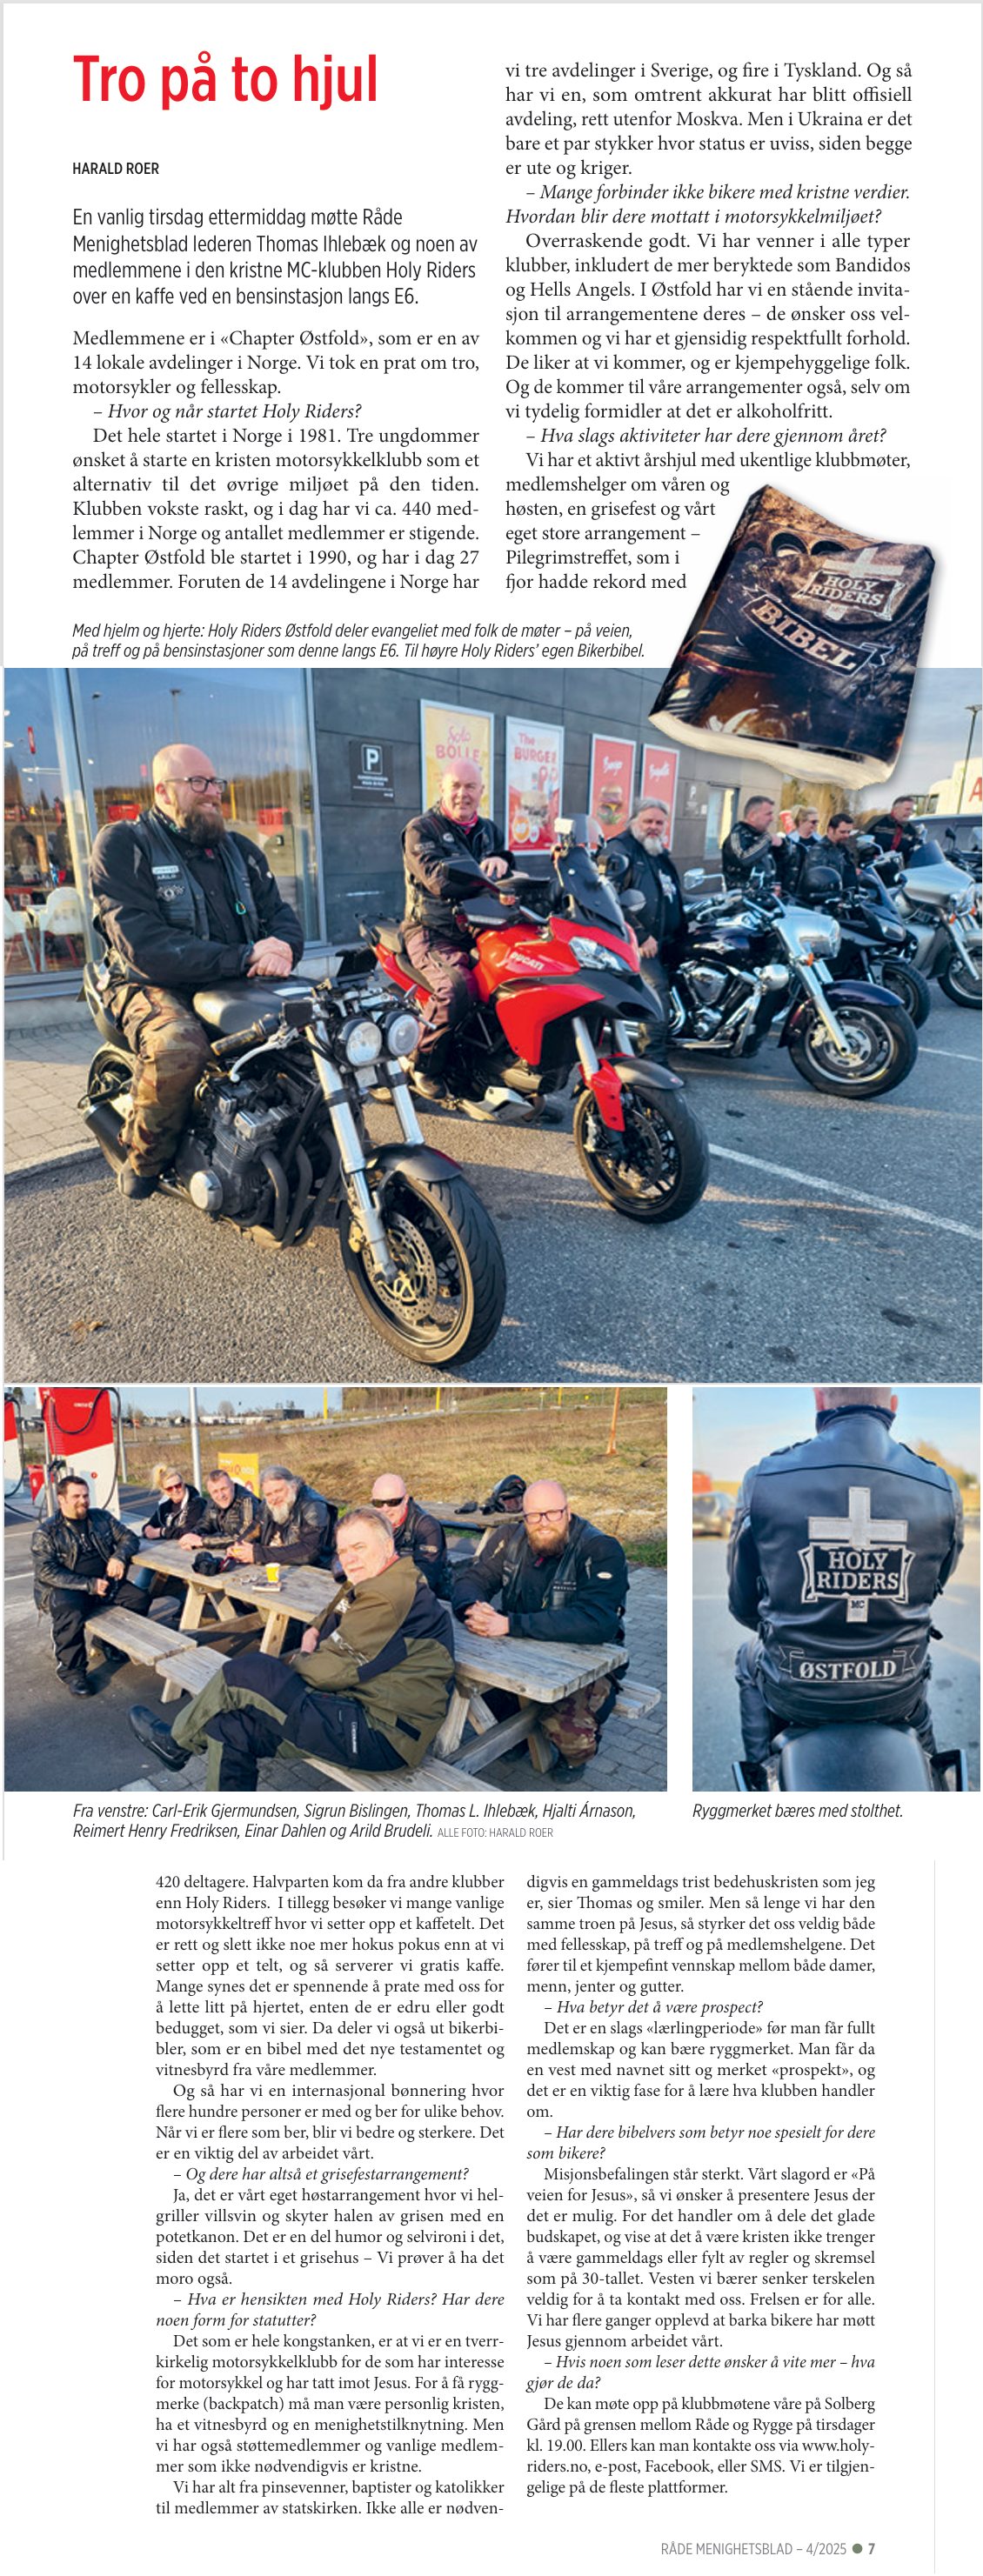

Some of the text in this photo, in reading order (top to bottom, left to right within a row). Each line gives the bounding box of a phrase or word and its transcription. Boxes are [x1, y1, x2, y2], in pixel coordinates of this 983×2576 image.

[73, 50, 376, 110] Tro på to hjul
[73, 163, 159, 174] HARALD ROER
[74, 207, 402, 228] En vanlig tirsdag ettermiddag møtte Råde
[74, 235, 478, 255] Menighetsblad lederen Thomas Ihlebæk og noen av
[74, 261, 475, 281] medlemmene i den kristne MC-klubben Holy Riders
[505, 257, 910, 275] klubber, inkludert de mer beryktede som Bandidos
[73, 287, 418, 307] over en kaffe ved en bensinstasjon langs E6.
[73, 378, 280, 398] motorsykler og fellesskap.
[108, 404, 148, 417] Hvor
[153, 408, 171, 423] og
[176, 404, 203, 417] når
[207, 405, 257, 417] startet
[263, 403, 300, 423] Holy
[304, 403, 362, 417] Riders?
[824, 576, 879, 593] HOLY
[809, 584, 884, 607] RIDERS
[72, 624, 101, 637] Med
[104, 624, 139, 639] hjelm
[144, 627, 160, 639] og
[163, 624, 204, 639] hjerte:
[208, 624, 237, 639] Holy
[241, 624, 282, 637] Riders
[285, 624, 332, 637] Østfold
[336, 624, 369, 637] deler
[371, 624, 438, 639] evangeliet
[441, 624, 471, 637] med
[474, 624, 498, 637] folk
[502, 624, 518, 637] de
[521, 624, 561, 637] møter
[575, 623, 591, 639] på
[597, 624, 632, 639] veien,
[752, 599, 858, 671] BIBEL
[72, 643, 644, 659] på treff og på bensinstasjoner som denne langs E6. Til høyre Holy Riders’ egen Bikerbibel.
[518, 731, 536, 745] The
[365, 748, 379, 771] P
[514, 746, 558, 764] BURGER
[510, 951, 545, 971] DUCATI
[828, 1551, 889, 1571] HOLY
[817, 1572, 899, 1591] RIDERS
[851, 1599, 866, 1609] MC
[799, 1660, 897, 1680] ØSTFOLD
[73, 1801, 635, 1819] Fra venstre: Carl-Erik Gjermundsen, Sigrun Bislingen, Thomas L. Ihlebæk, Hjalti Árnason,
[692, 1804, 902, 1819] Ryggmerket bæres med stolthet.
[73, 1824, 552, 1839] Reimert Henry Fredriksen, Einar Dahlen og Arild Brudeli. ALLE FOTO: HARALD ROER
[157, 1917, 505, 1933] motorsykkeltreff hvor vi setter opp et kaffetelt. Det
[156, 2063, 376, 2079] vitnesbyrd fra våre medlemmer.
[527, 2334, 722, 2351] Jesus gjennom arbeidet vårt.
[527, 2459, 591, 2473] riders.no,
[595, 2462, 640, 2476] e-post,
[645, 2459, 713, 2473] Facebook,
[718, 2459, 746, 2472] eller
[751, 2460, 785, 2472] SMS.
[790, 2460, 805, 2472] Vi
[826, 2459, 874, 2476] tilgjen-
[662, 2541, 692, 2554] RÅDE
[697, 2543, 792, 2554] MENIGHETSBLAD
[806, 2542, 846, 2556] 4/2025
[869, 2543, 875, 2554] 7
